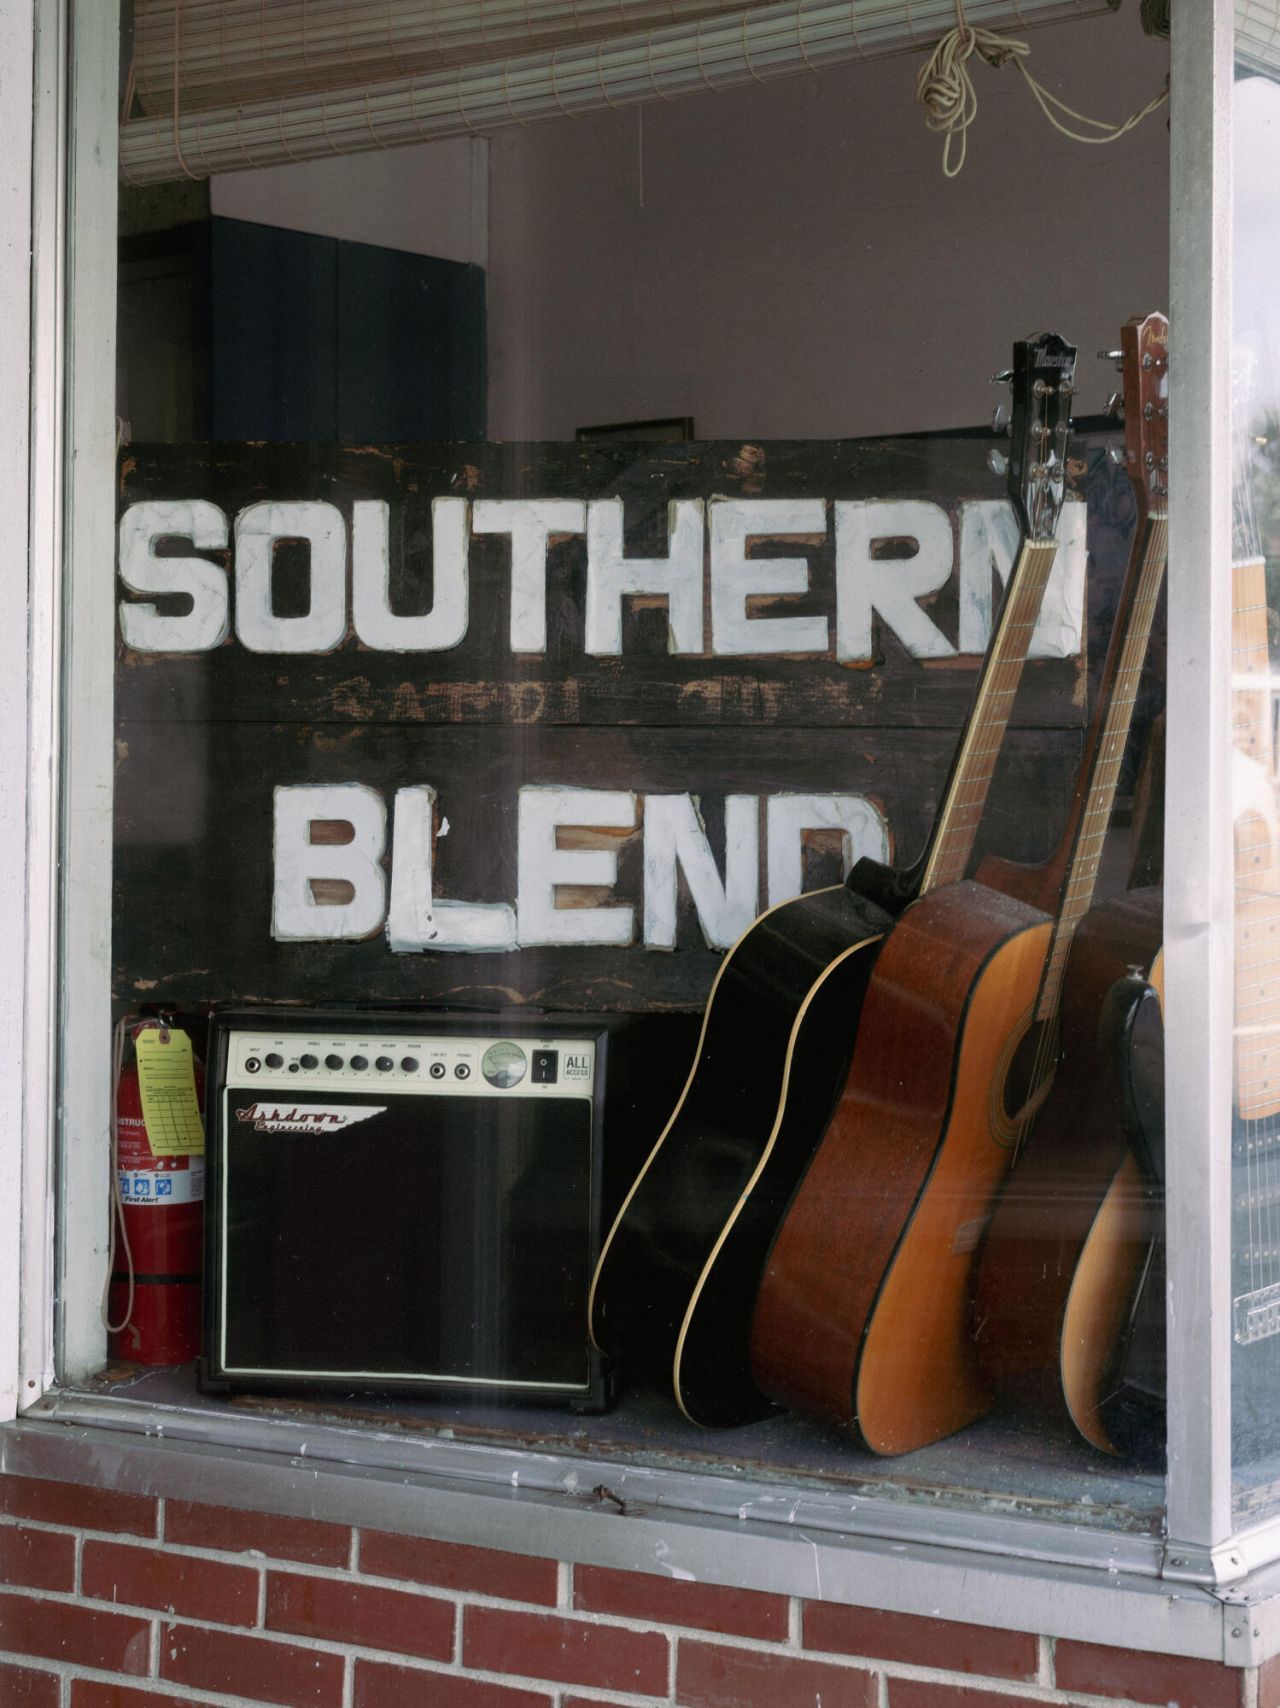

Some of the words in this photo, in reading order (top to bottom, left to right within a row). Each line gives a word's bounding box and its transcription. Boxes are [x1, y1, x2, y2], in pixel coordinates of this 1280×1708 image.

[118, 496, 1089, 662] SOUTHERN
[270, 782, 893, 953] BLEND
[566, 1056, 588, 1069] ALL
[236, 1103, 344, 1124] Ashdown
[256, 1121, 323, 1134] Engineering
